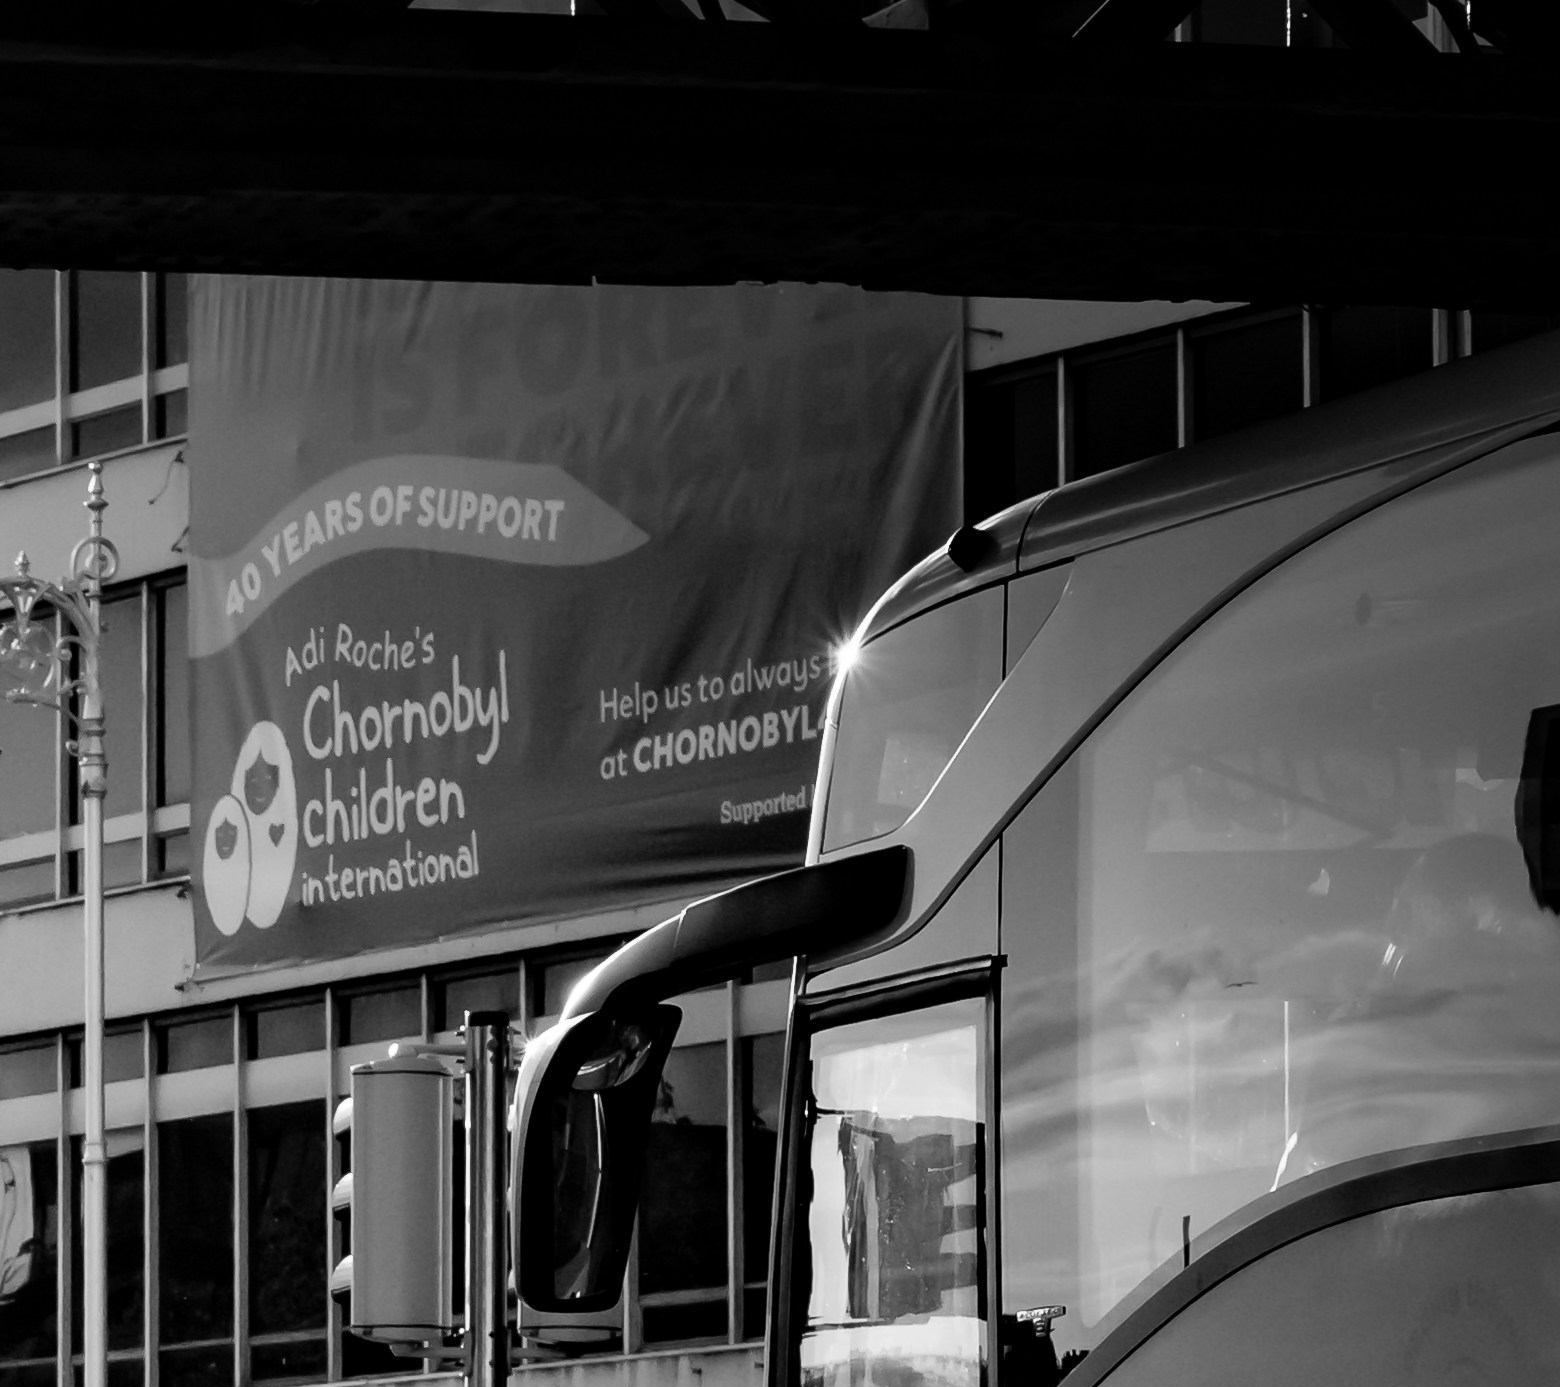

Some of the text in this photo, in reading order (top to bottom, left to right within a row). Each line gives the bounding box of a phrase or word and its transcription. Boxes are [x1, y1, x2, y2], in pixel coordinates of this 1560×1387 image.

[225, 485, 566, 617] 40 YEARS OF SUPPORT
[285, 622, 435, 687] Adi Roche's
[600, 681, 658, 724] Help
[664, 682, 692, 710] us
[697, 674, 725, 703] to
[730, 657, 820, 695] always
[303, 649, 510, 765] Chornobyl
[600, 704, 826, 780] at CHORNOBYL
[303, 757, 466, 848] children
[720, 785, 806, 825] Supported
[302, 829, 480, 907] international
